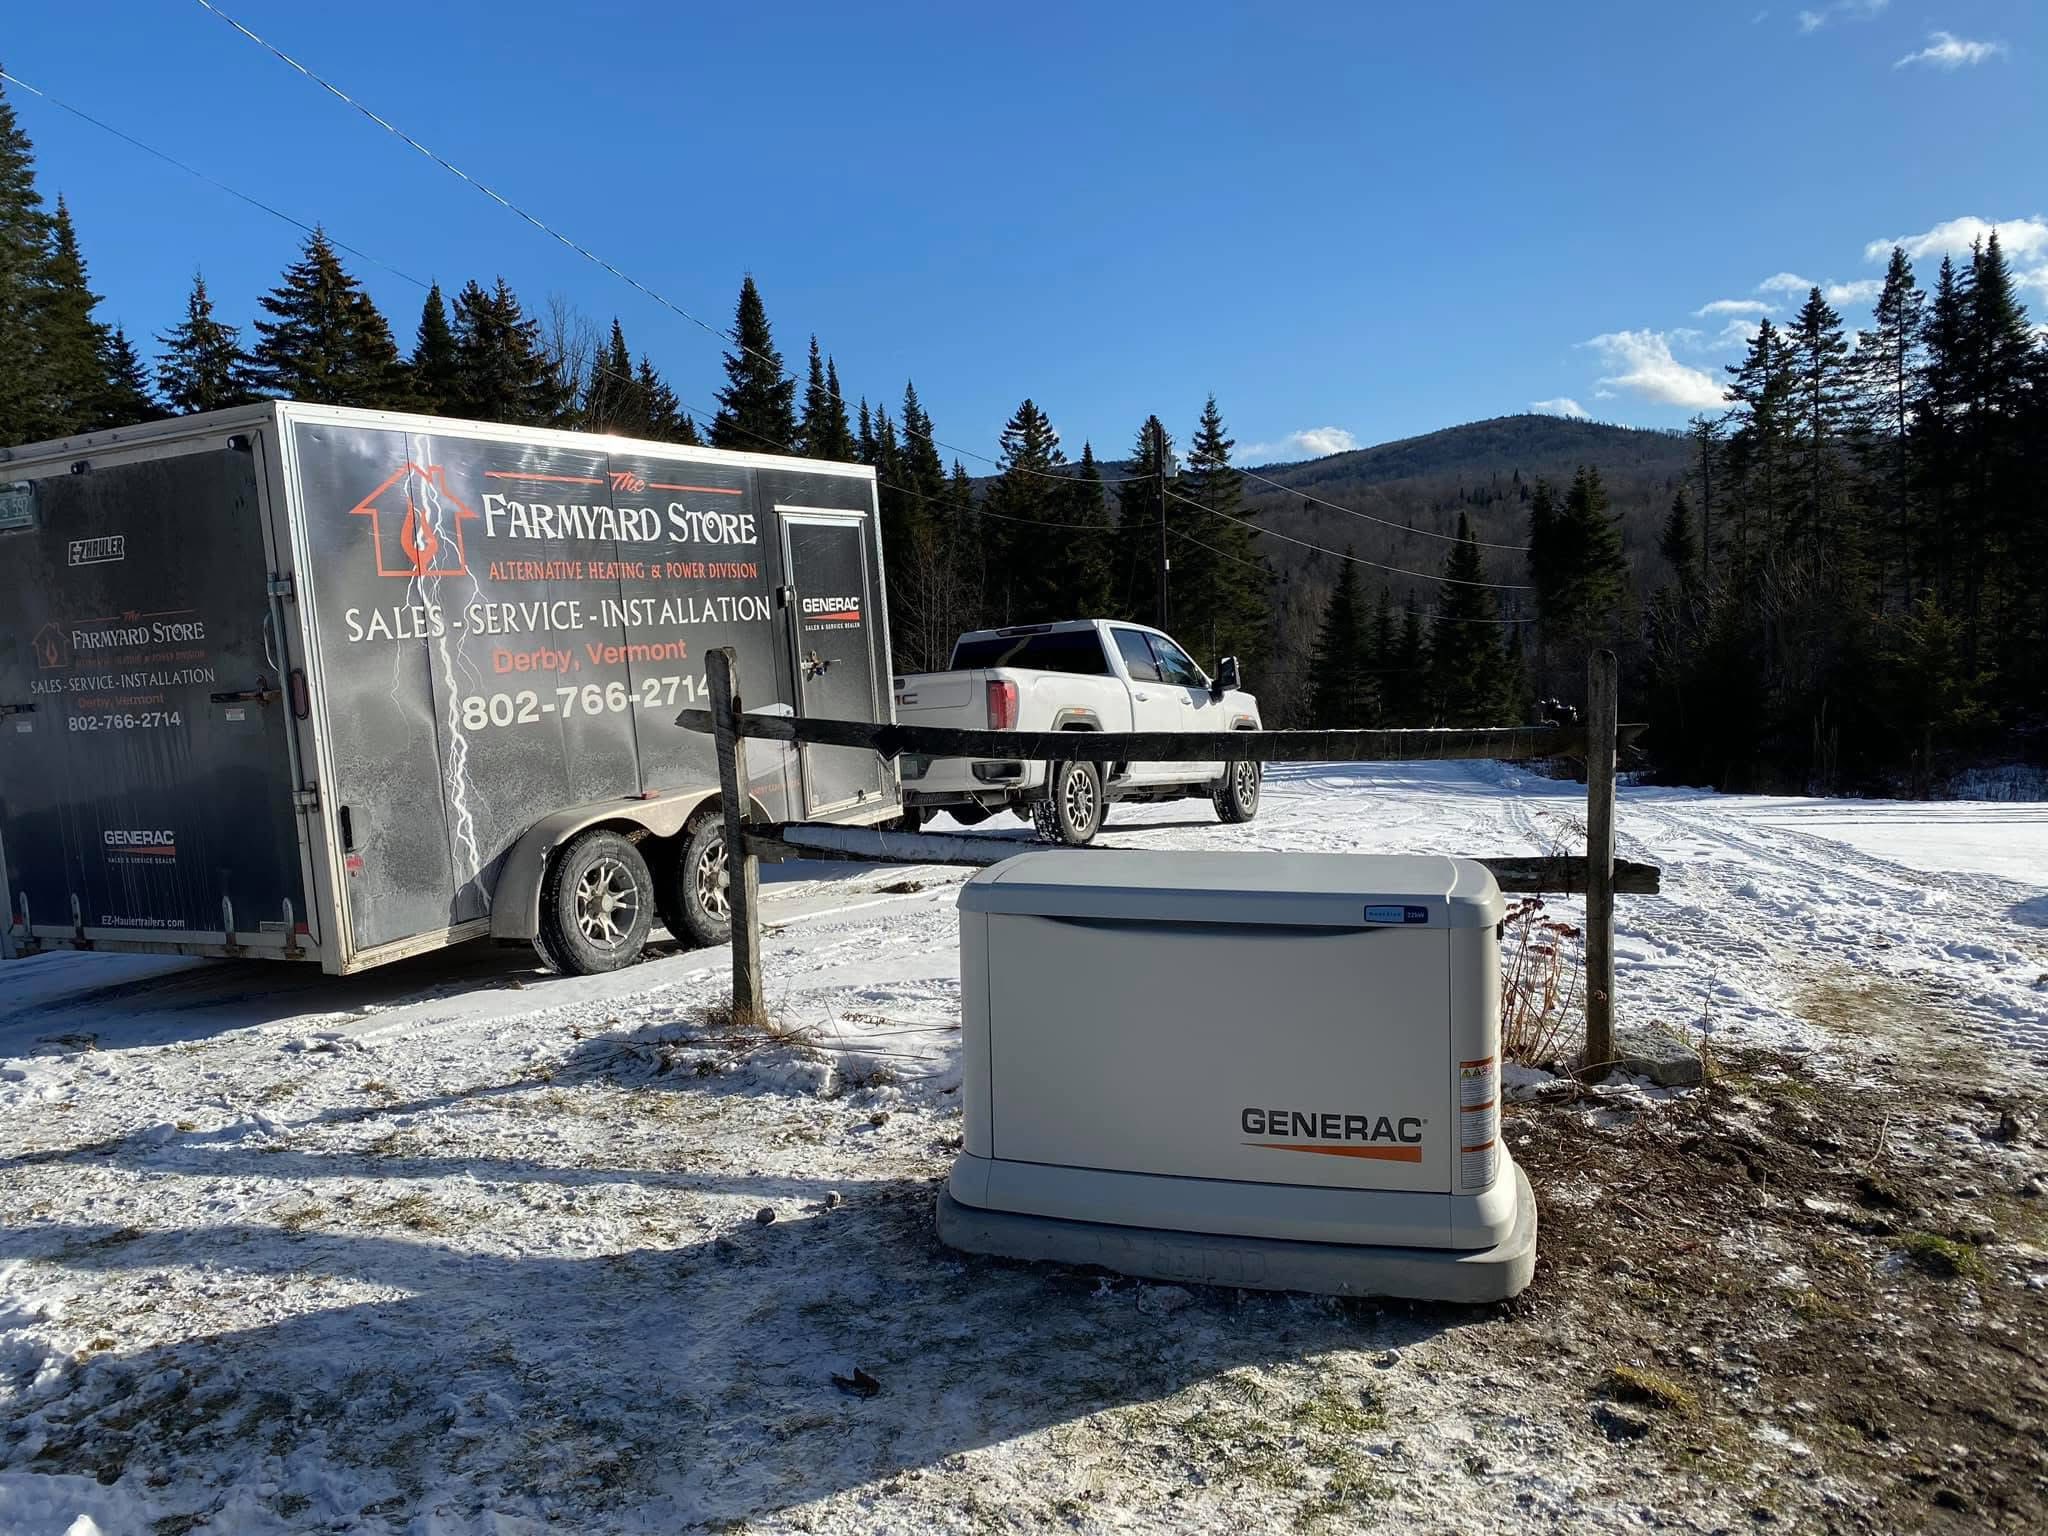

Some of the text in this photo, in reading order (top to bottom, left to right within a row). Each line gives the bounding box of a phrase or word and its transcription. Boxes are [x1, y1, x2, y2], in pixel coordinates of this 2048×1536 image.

[607, 472, 645, 493] The
[481, 493, 758, 545] FARMYARD STORE
[488, 560, 758, 581] ALTERNATIVE HEATING & POWER DIVISION
[344, 605, 446, 643] SALES
[468, 600, 584, 636] SERVICE
[600, 595, 772, 629] INSTALLATION
[802, 597, 860, 613] GENERAC
[72, 622, 205, 650] FARMYARD STORE
[491, 639, 688, 674] Derby, Vermont
[30, 679, 62, 695] SALES
[68, 675, 115, 692] SERVICE
[121, 667, 216, 689] INSTALLATION
[116, 693, 165, 706] Vermont
[462, 674, 710, 732] 802-766-2714
[68, 711, 182, 732] 802-766-2714
[104, 830, 175, 845] GENERAC
[1241, 1107, 1423, 1144] GENERAC
